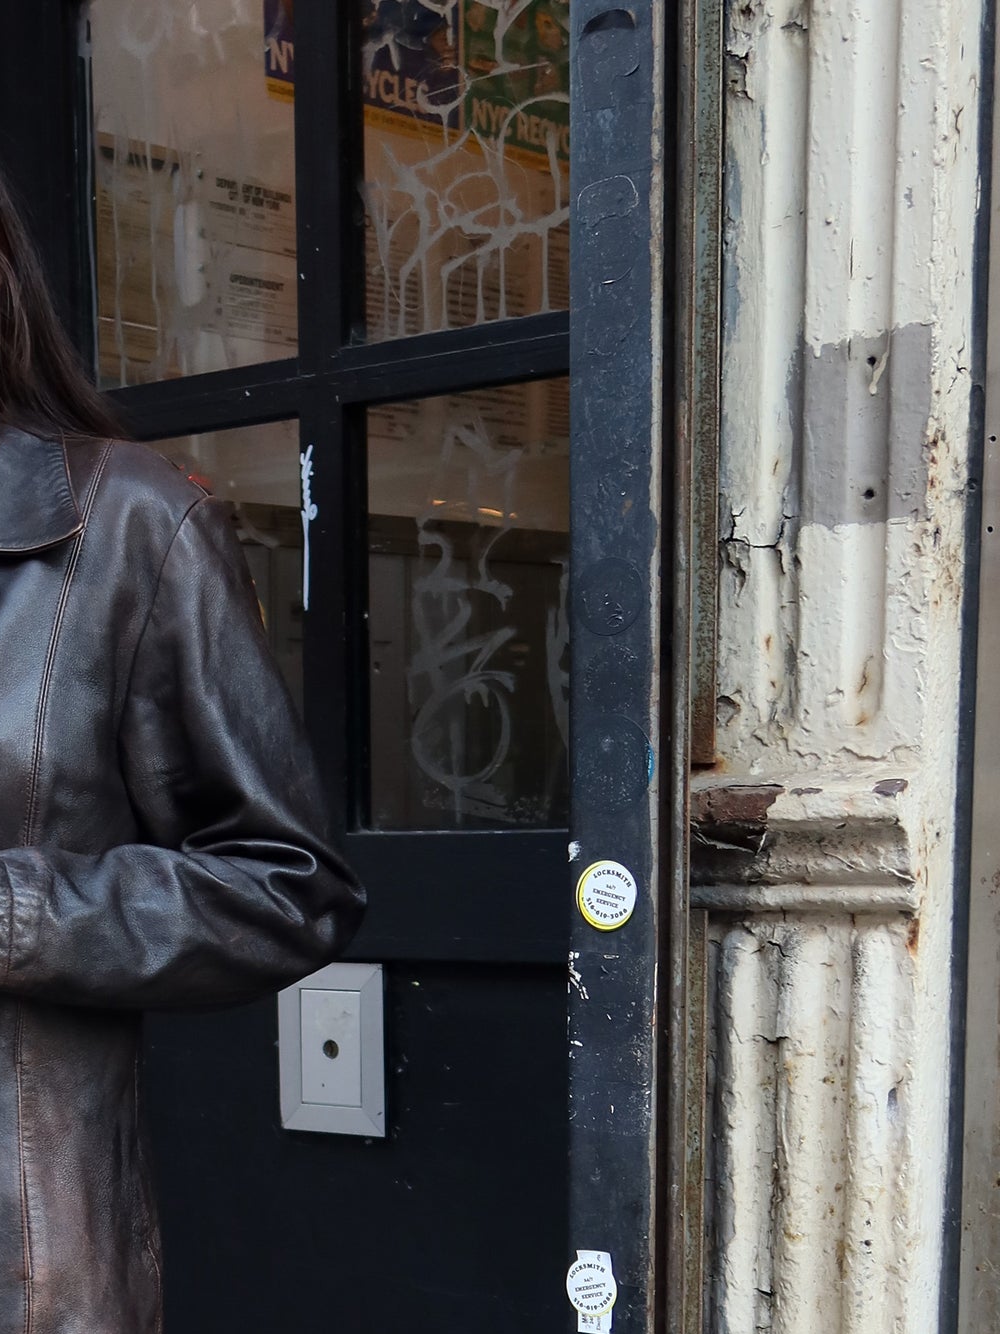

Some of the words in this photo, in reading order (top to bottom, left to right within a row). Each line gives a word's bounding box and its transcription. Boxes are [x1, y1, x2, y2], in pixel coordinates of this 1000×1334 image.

[593, 869, 632, 888] LOCKSMITH
[593, 888, 626, 901] EMERGENCY
[596, 898, 619, 909] SERVICE
[569, 1263, 605, 1279] LOCKSMITH
[575, 1283, 606, 1293] EMERGENCY
[582, 1292, 603, 1300] SERVICE
